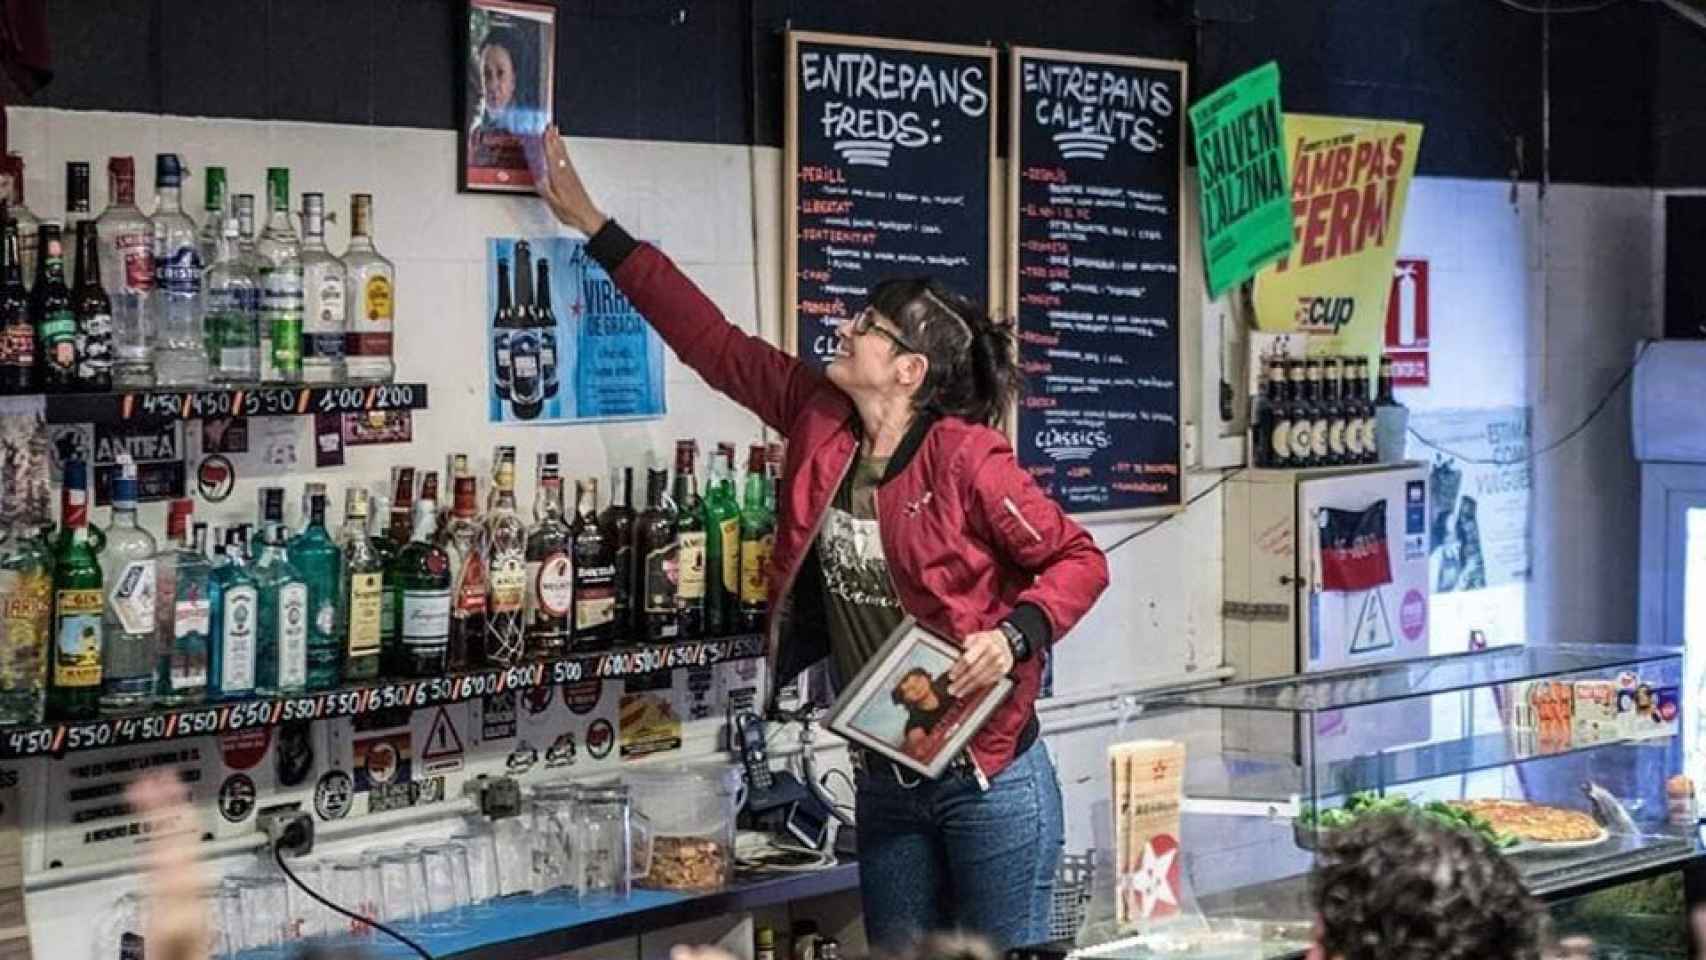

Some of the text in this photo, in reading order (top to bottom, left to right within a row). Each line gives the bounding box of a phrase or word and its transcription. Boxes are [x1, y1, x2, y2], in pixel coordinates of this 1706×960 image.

[802, 52, 988, 117] ENTREPANS
[1024, 63, 1173, 117] ENTREPANS
[821, 102, 943, 148] FREDS:
[1035, 98, 1165, 153] CALENTS:
[1201, 98, 1280, 188] SALVEM
[1293, 143, 1352, 200] AMB
